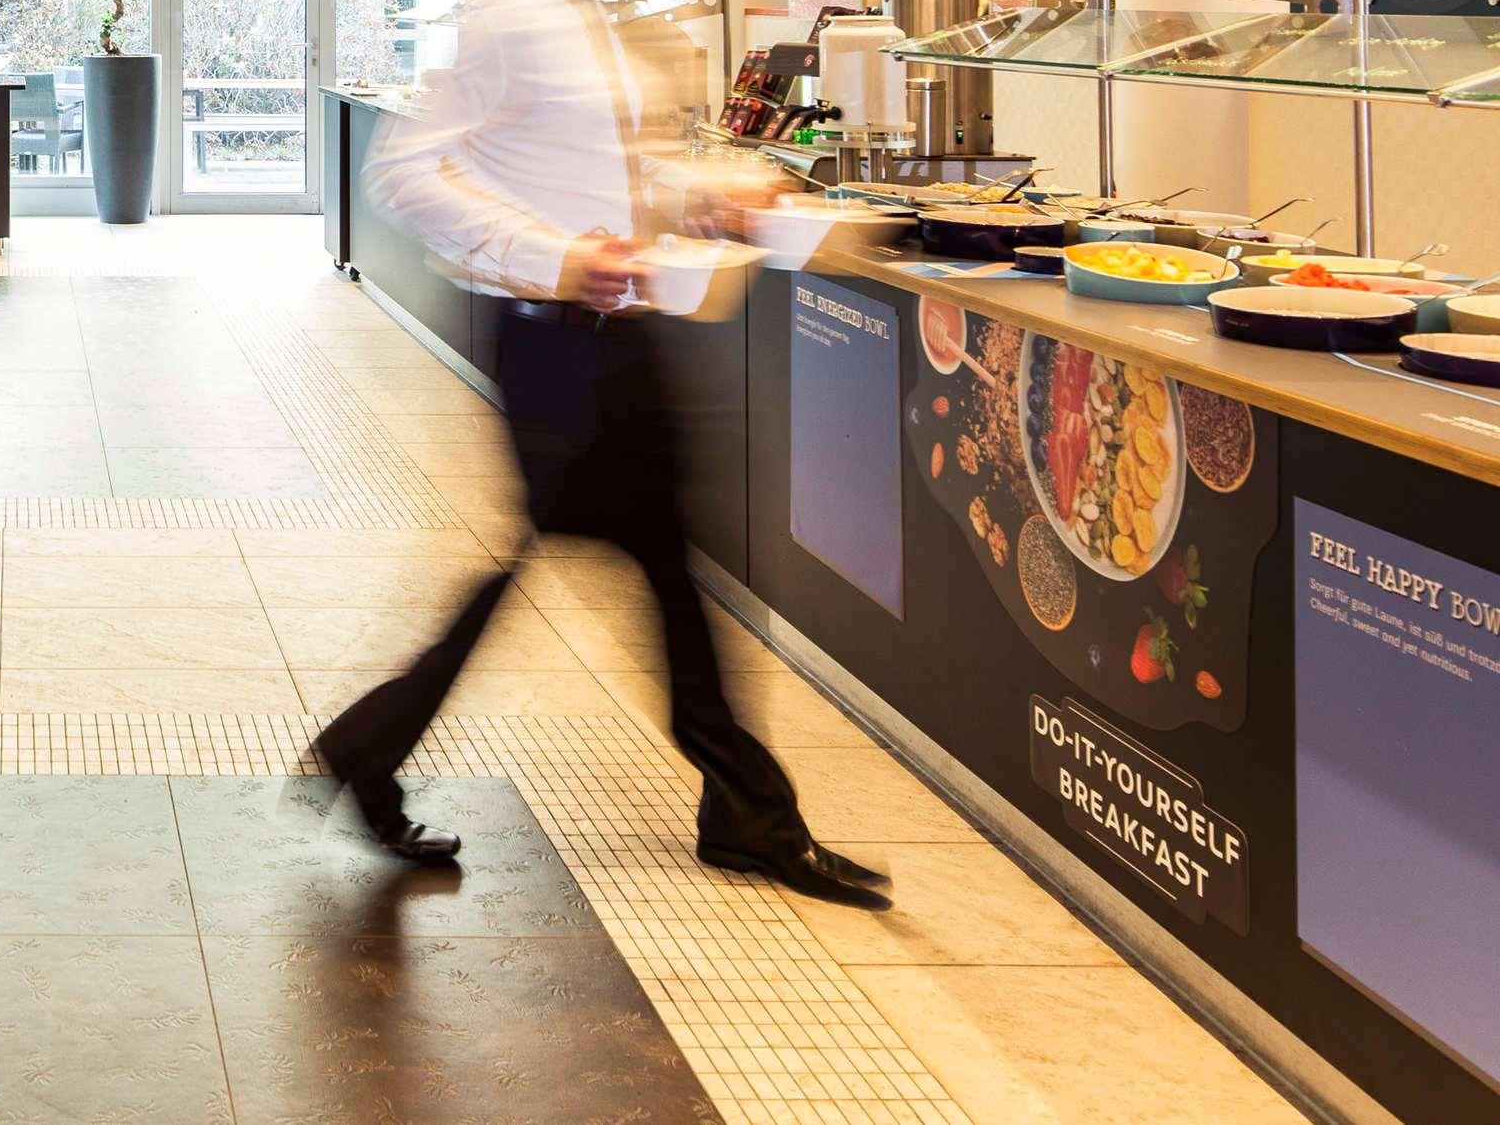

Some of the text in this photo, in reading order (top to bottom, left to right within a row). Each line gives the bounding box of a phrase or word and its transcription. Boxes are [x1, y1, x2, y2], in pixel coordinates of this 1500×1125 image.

[796, 286, 815, 308] FEEL
[865, 315, 890, 339] BOWL
[1309, 531, 1361, 575] FEEL
[1366, 555, 1443, 610] HAPPY
[1308, 577, 1334, 599] Sorgt
[1336, 586, 1350, 603] für
[1351, 598, 1373, 616] gute
[1374, 606, 1407, 632] Laune,
[1409, 619, 1422, 638] ist
[1423, 630, 1444, 648] süß
[1446, 642, 1466, 658] und
[1309, 597, 1350, 625] Cheerful,
[1352, 618, 1380, 638] sweet
[1381, 632, 1401, 649] and
[1402, 641, 1418, 657] yet
[1034, 704, 1240, 865] DO-IT-YOURSELF
[1059, 767, 1209, 898] BREAKFAST
